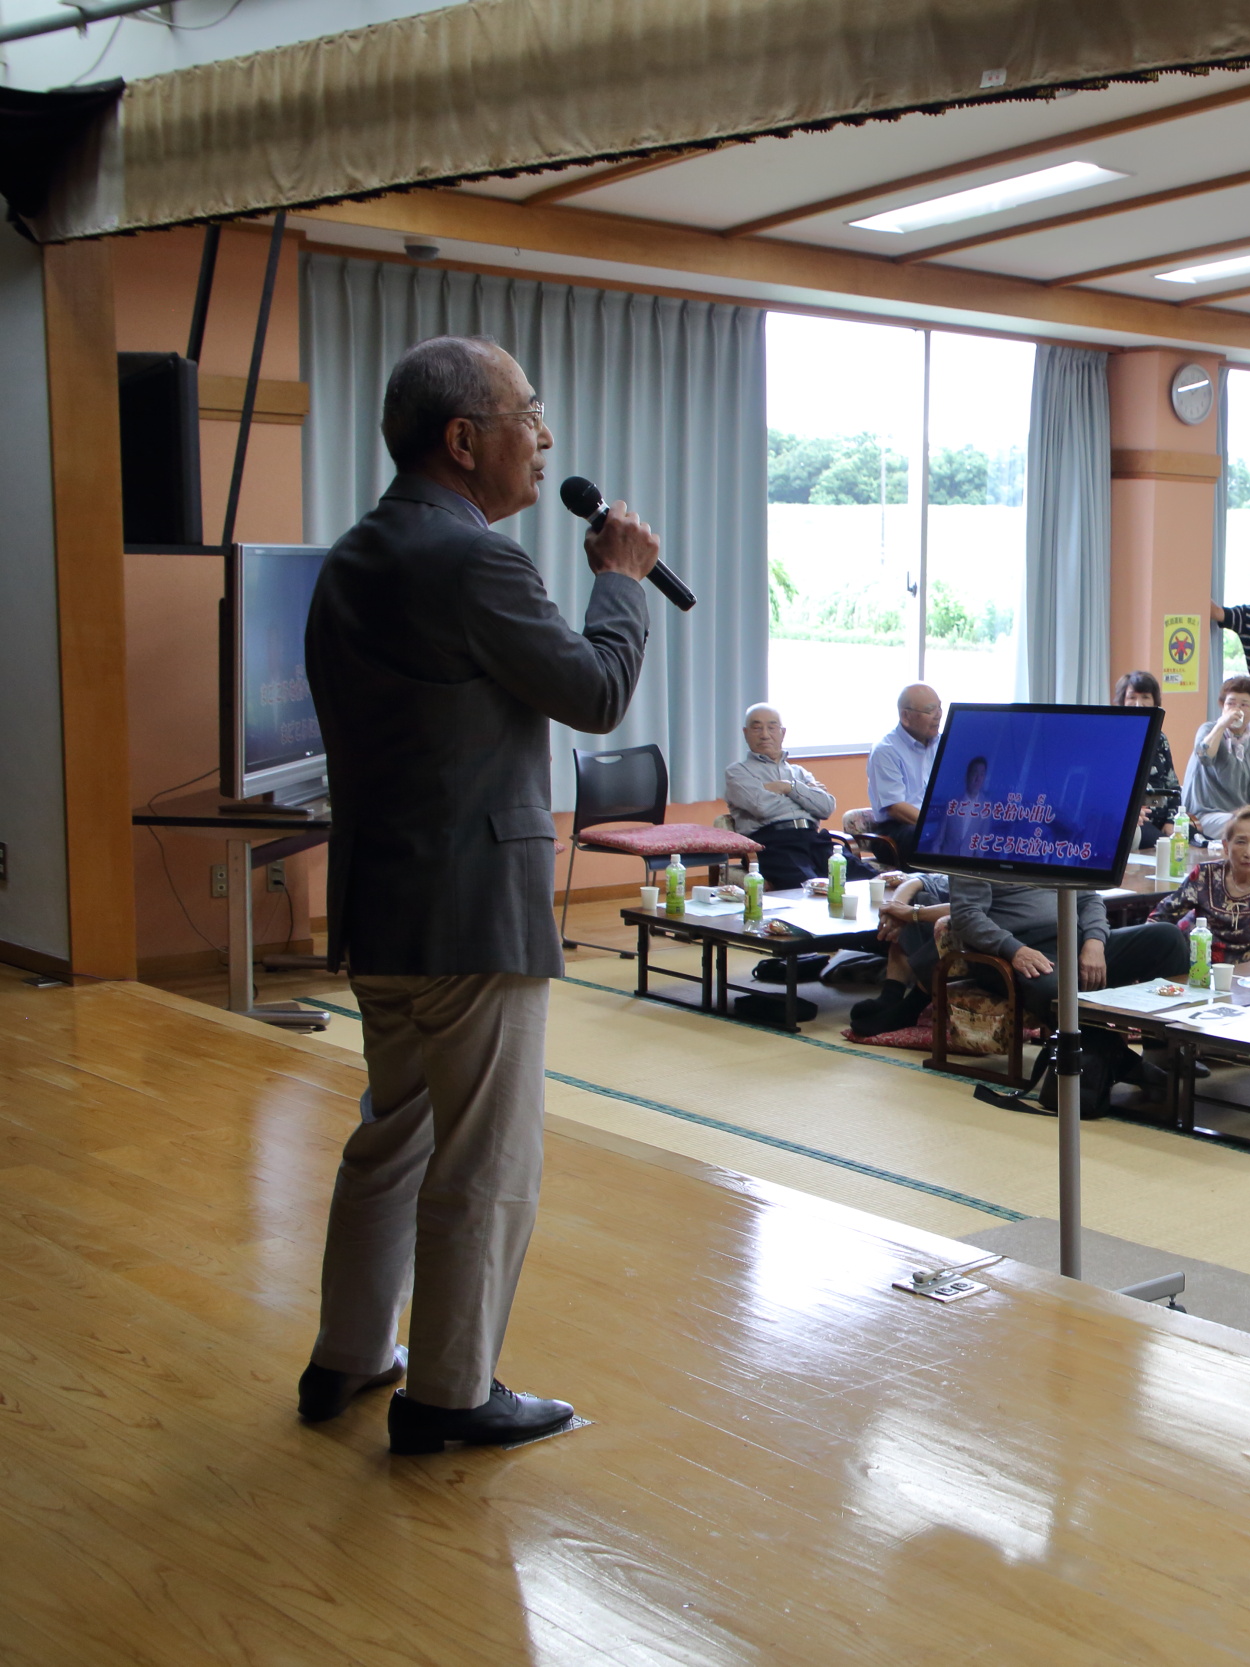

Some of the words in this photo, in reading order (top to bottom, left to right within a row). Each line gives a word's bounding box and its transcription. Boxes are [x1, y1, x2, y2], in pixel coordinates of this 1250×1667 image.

[947, 800, 1055, 823] まごころを拾い出し
[969, 833, 1091, 860] まごころに泣いている
